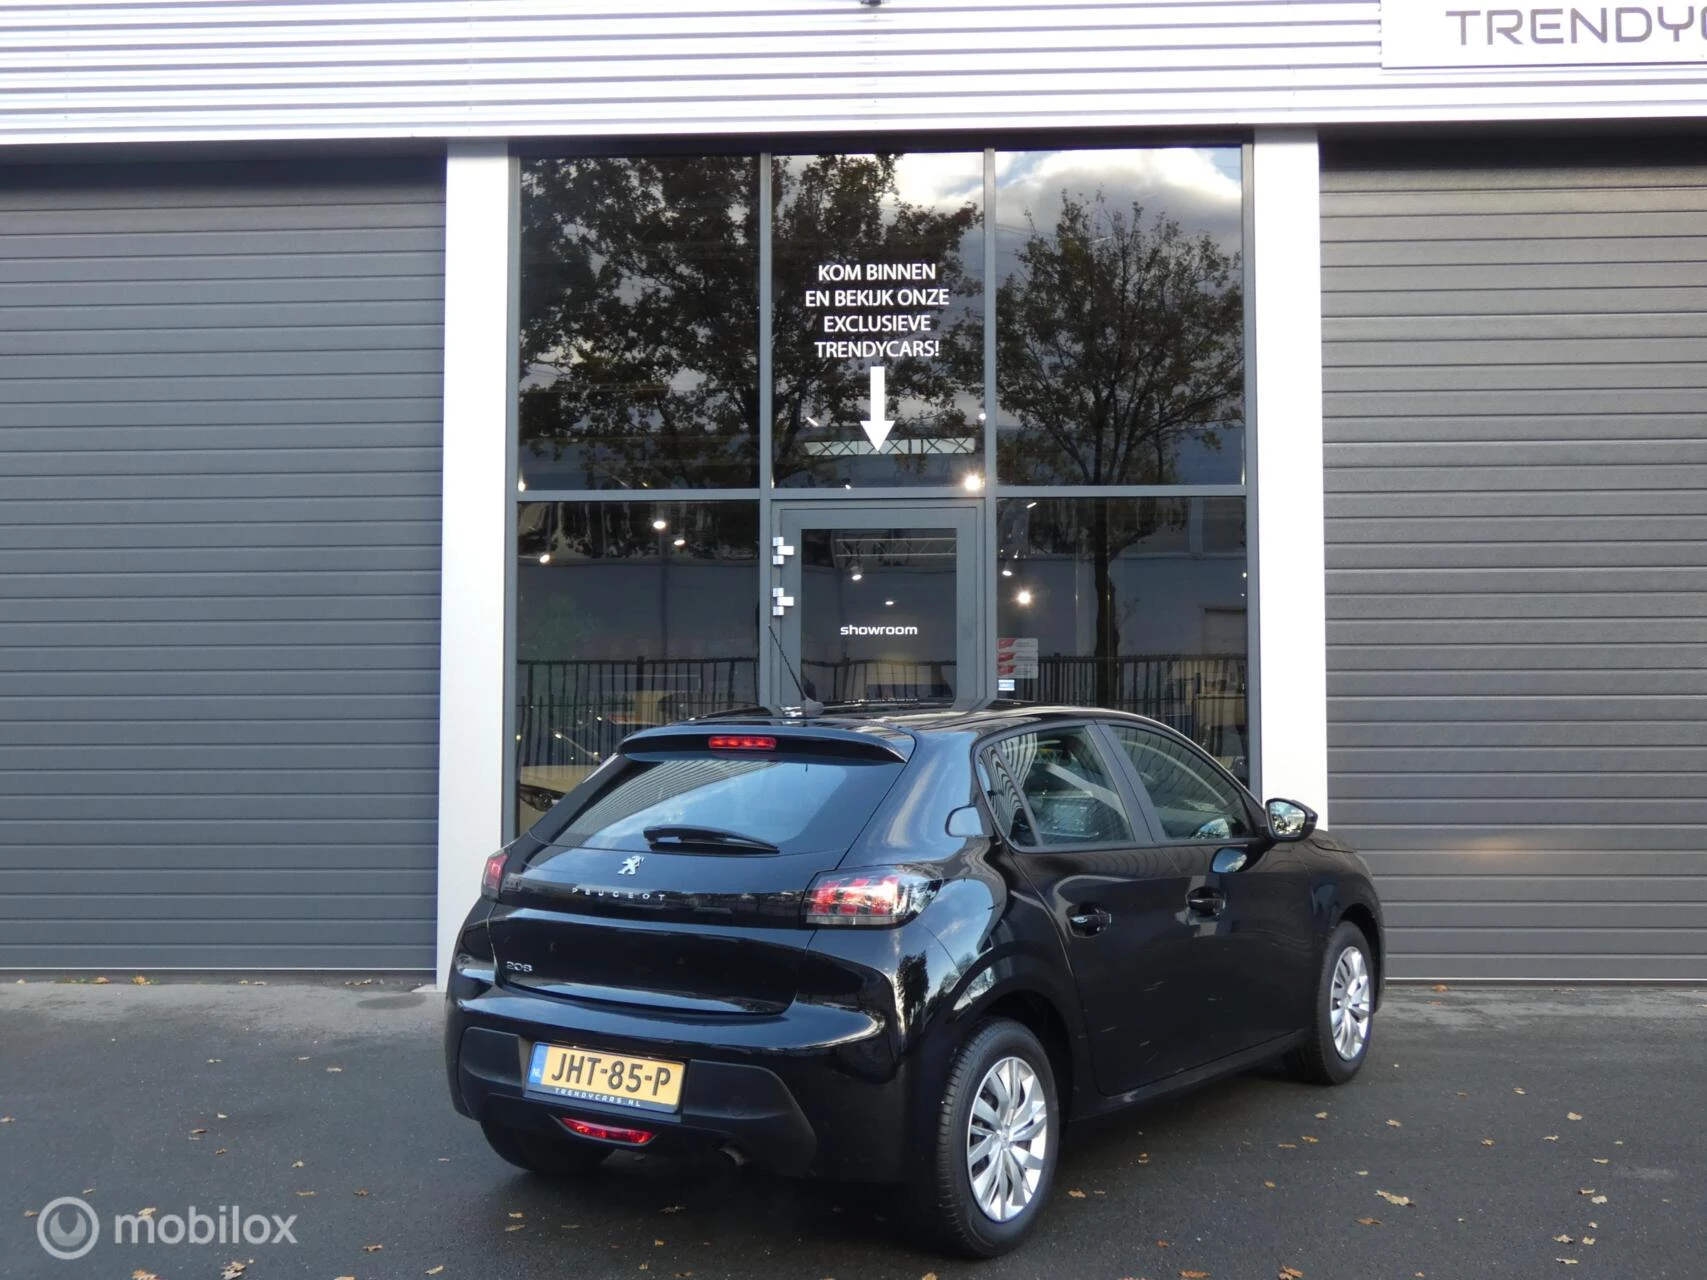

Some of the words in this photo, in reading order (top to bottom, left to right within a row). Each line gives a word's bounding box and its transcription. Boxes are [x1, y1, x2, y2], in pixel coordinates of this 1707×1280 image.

[1446, 6, 1707, 45] TRENDY
[818, 265, 861, 281] KOM
[866, 263, 936, 280] BINNEN
[805, 290, 830, 307] EN
[834, 289, 894, 306] BEKIJK
[897, 288, 950, 305] ONZE
[824, 315, 931, 332] EXCLUSIEVE
[814, 340, 940, 358] TRENDYCARS!
[840, 624, 918, 636] showroom
[571, 887, 665, 901] PEUGEOT
[506, 960, 533, 973] 208
[551, 1053, 671, 1096] JHT-85-P
[554, 1087, 641, 1107] TRENDYCARS.NL
